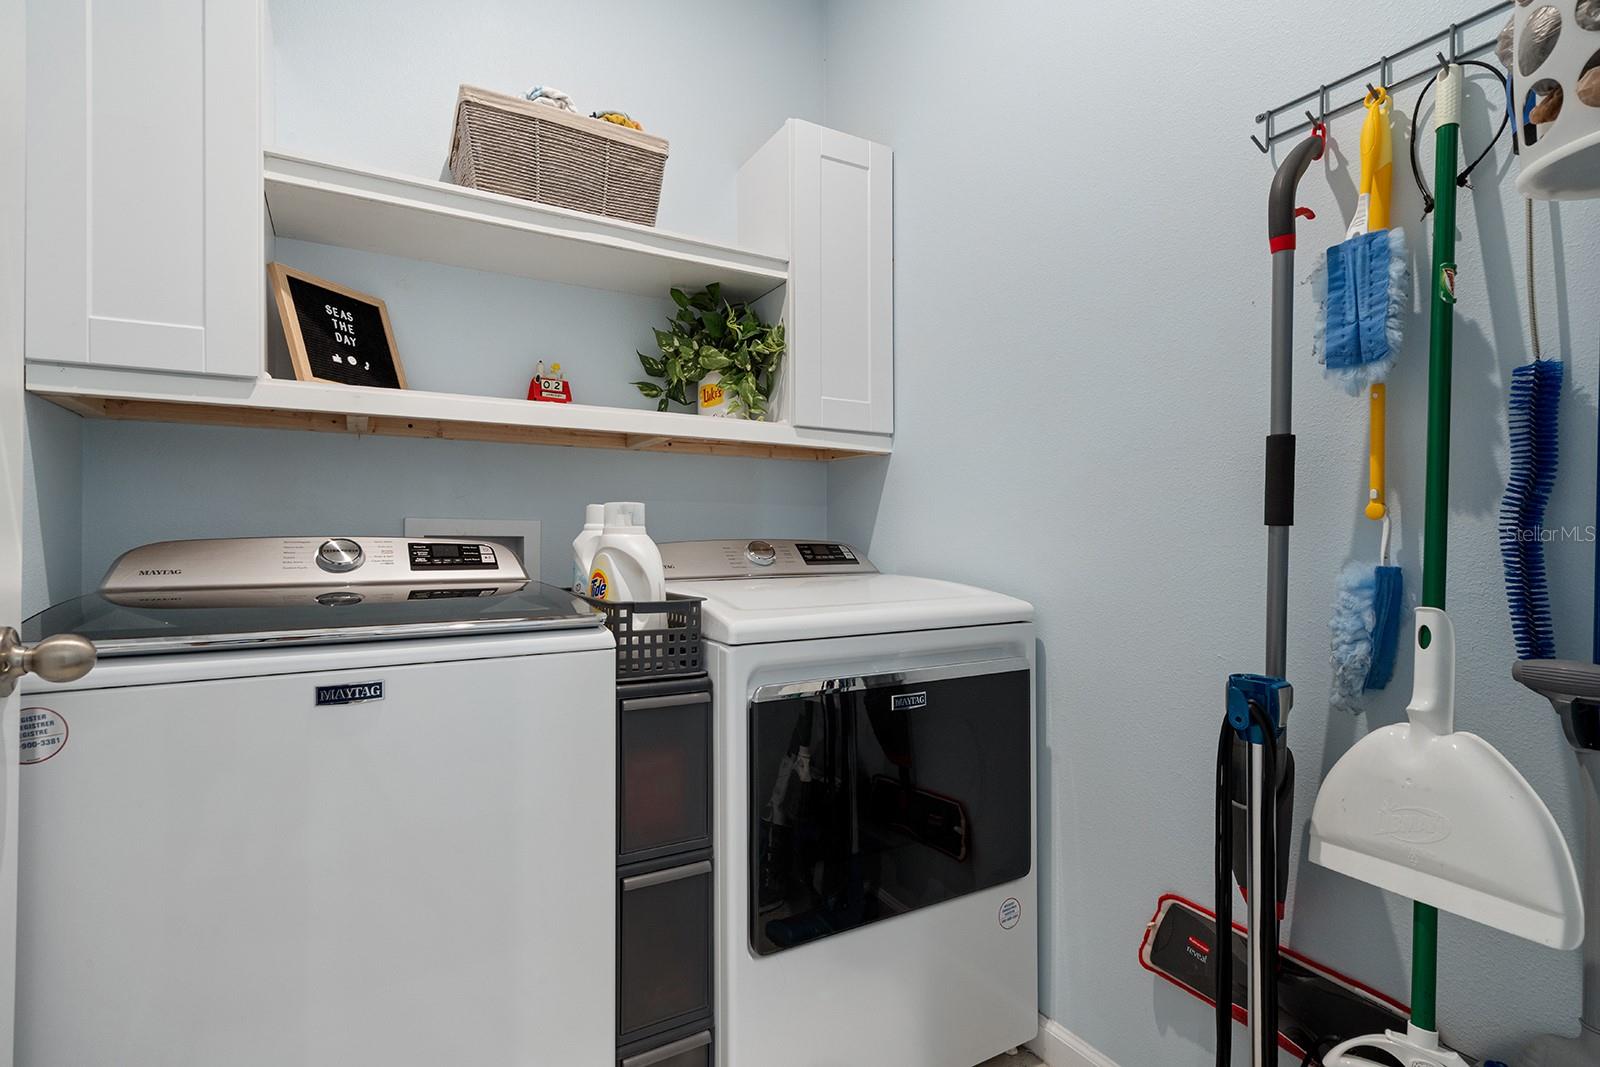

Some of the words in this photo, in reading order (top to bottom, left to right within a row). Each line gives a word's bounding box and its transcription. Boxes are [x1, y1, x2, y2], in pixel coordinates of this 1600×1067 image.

[325, 304, 353, 322] SEAS
[331, 318, 355, 335] THE
[335, 332, 357, 347] DAY
[591, 578, 606, 597] Tide
[320, 685, 381, 701] MAYTAG
[895, 695, 925, 706] MAYTAG
[1186, 945, 1208, 964] reveal
